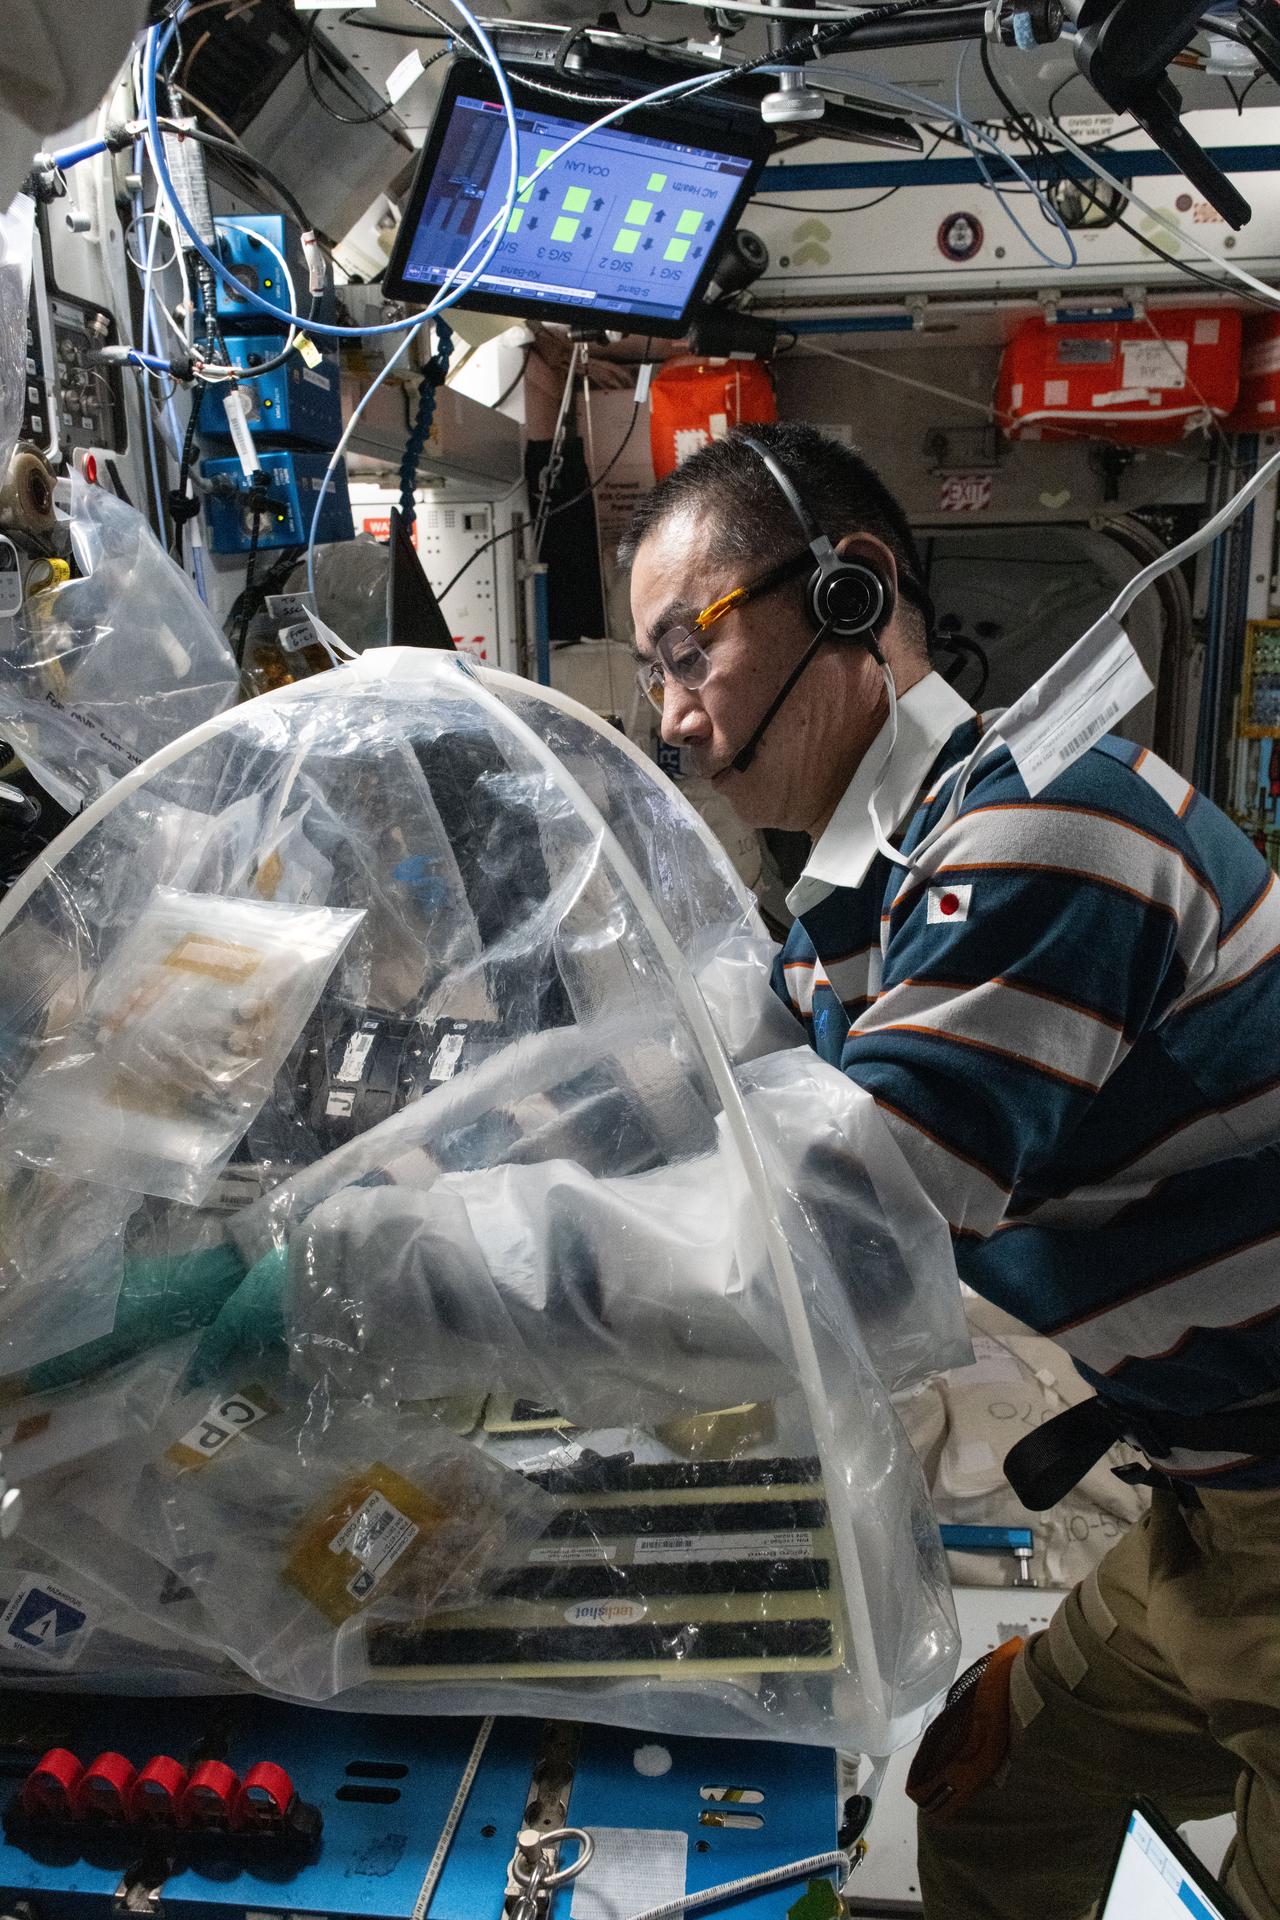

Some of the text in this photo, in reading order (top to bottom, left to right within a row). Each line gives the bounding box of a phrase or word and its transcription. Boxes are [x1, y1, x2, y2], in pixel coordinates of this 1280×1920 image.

[564, 160, 610, 177] OCA LAN
[671, 180, 699, 197] Health
[537, 247, 573, 264] S/G 3
[599, 257, 633, 273] S/G 2
[660, 268, 683, 281] S/G
[616, 284, 650, 297] S-Band
[575, 1604, 634, 1619] techshot
[40, 1619, 52, 1637] 1
